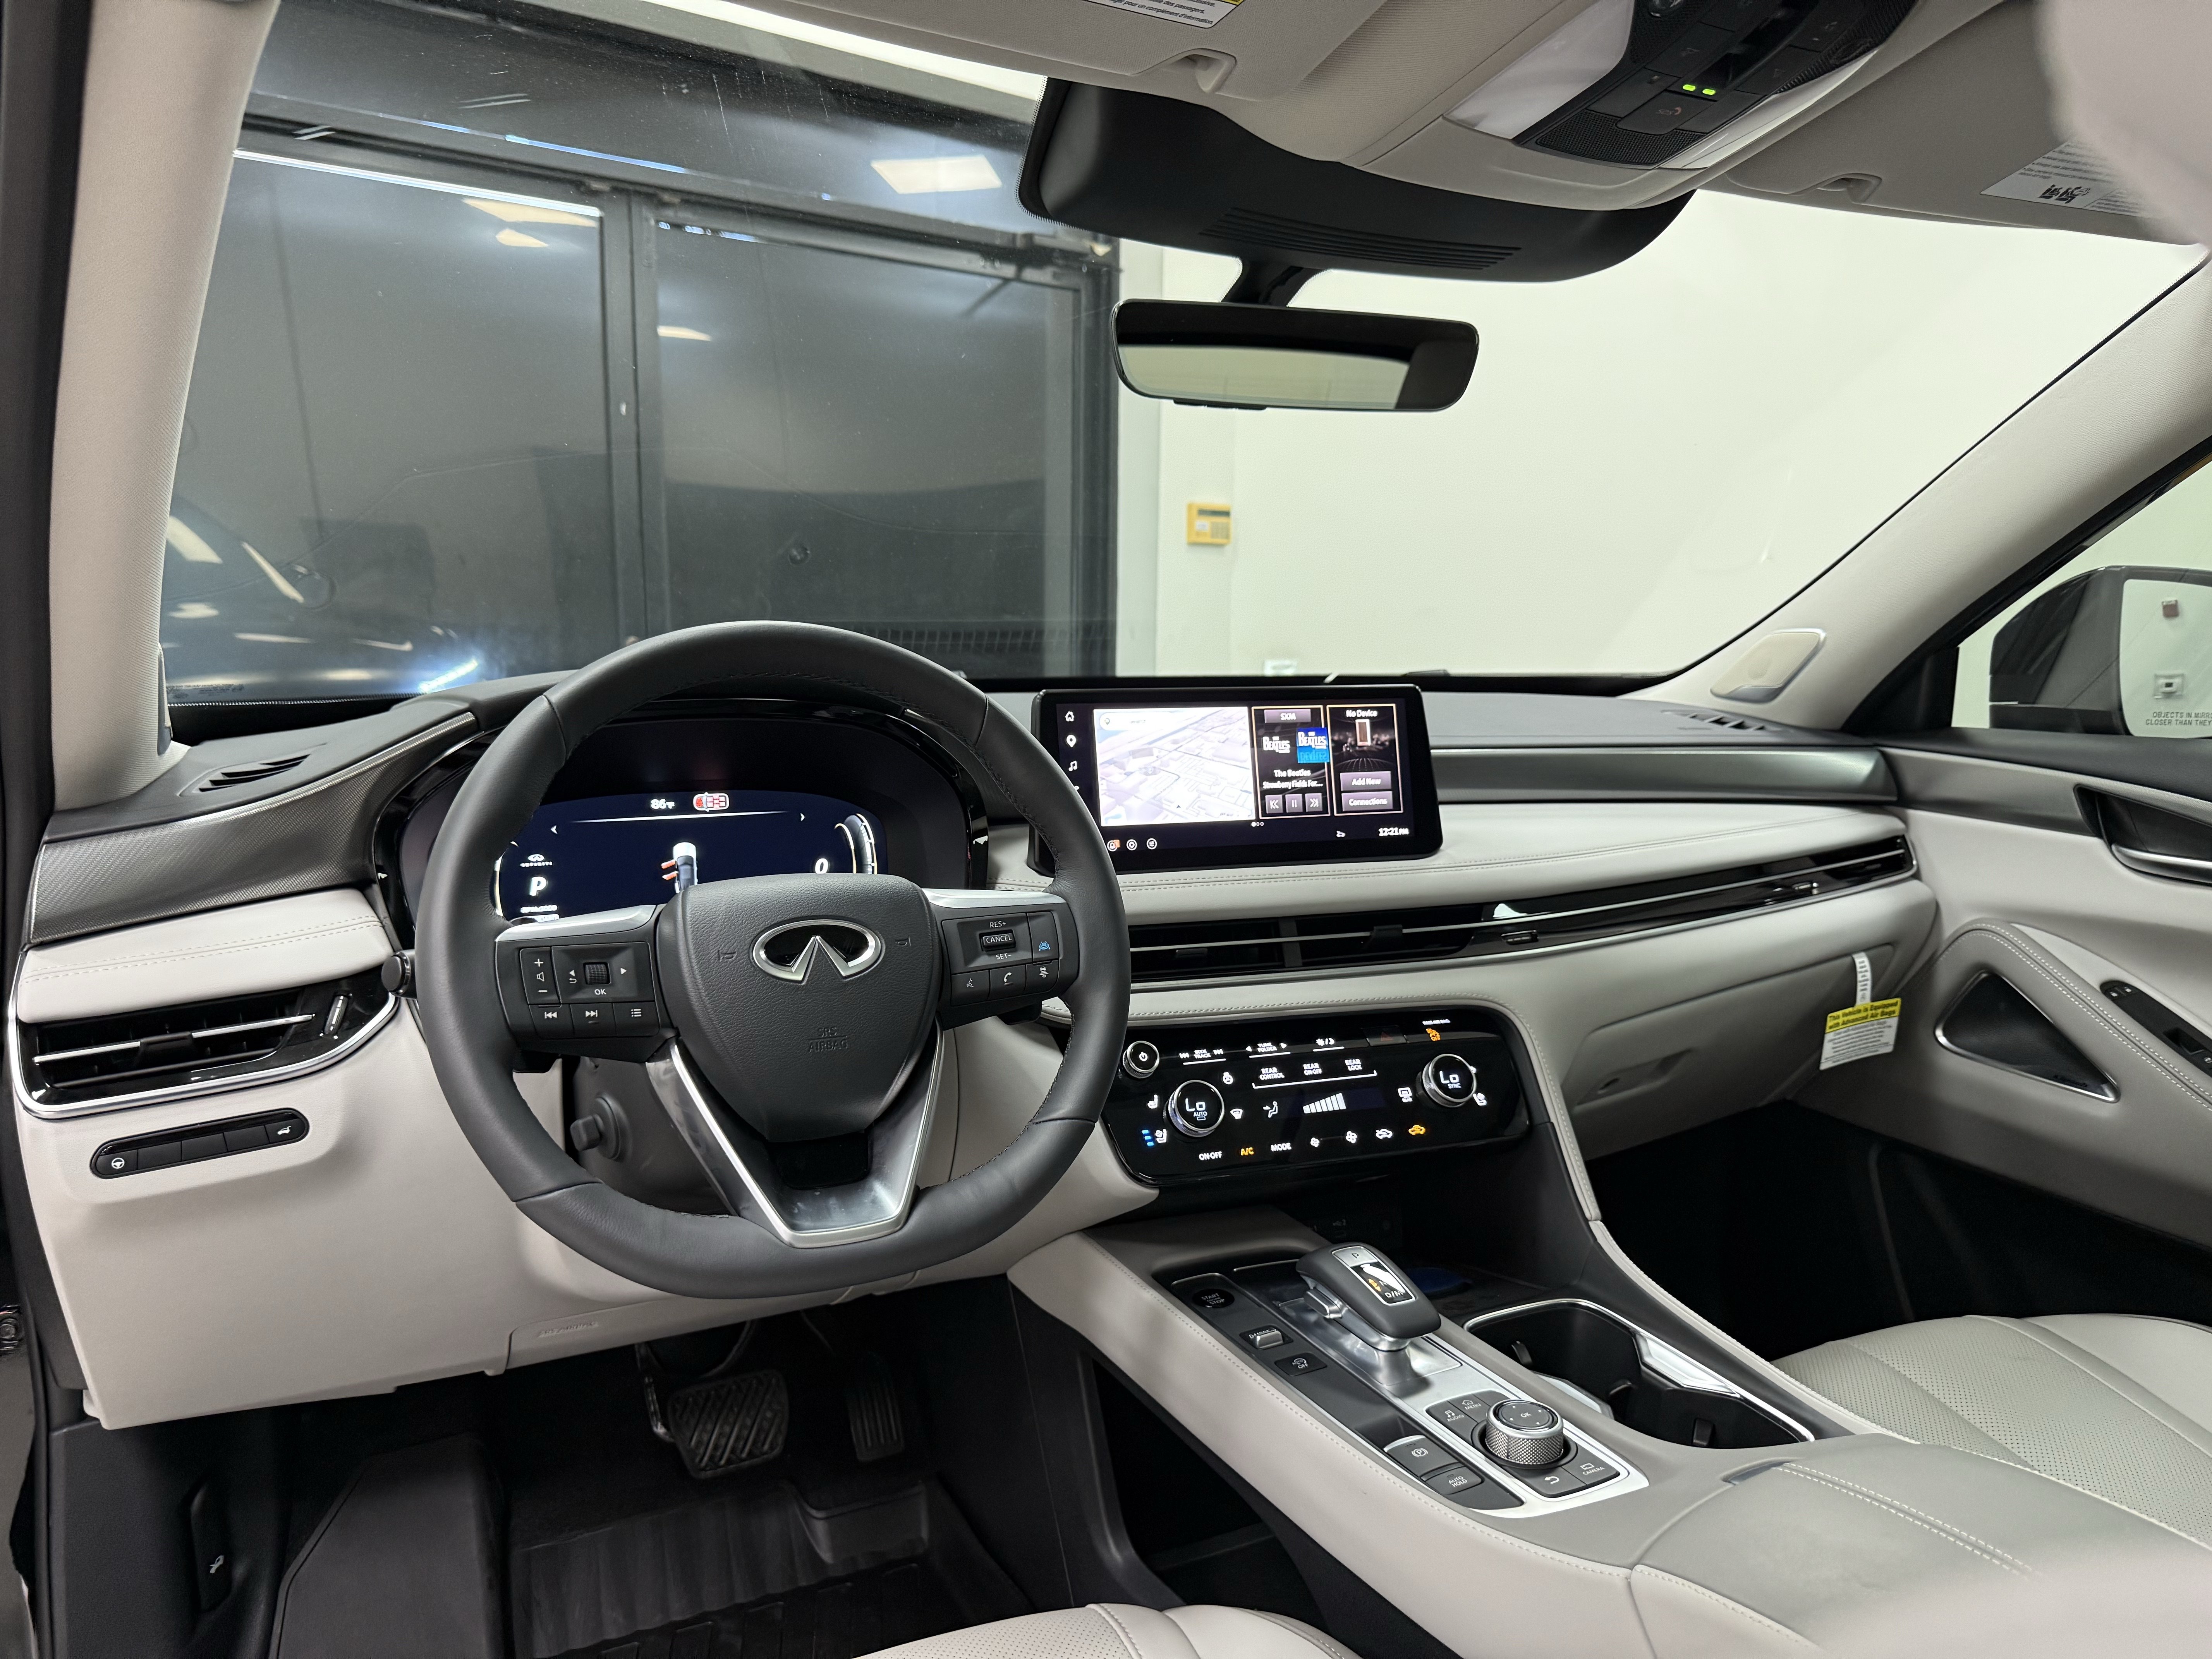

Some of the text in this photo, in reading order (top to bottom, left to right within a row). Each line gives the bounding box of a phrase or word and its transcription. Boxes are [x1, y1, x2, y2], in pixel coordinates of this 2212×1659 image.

[1287, 769, 1311, 777] Beatles
[1349, 798, 1387, 806] Connections
[1379, 827, 1399, 836] 12:21
[815, 858, 828, 874] 0
[529, 876, 547, 896] P
[986, 935, 1012, 943] CANCEL
[809, 1040, 848, 1053] AIRBAG
[1271, 1142, 1291, 1152] MODE
[1240, 1147, 1254, 1156] A/C
[1583, 1467, 1605, 1475] CAMERA
[1448, 1476, 1463, 1484] AUTO
[1451, 1479, 1467, 1487] HOLD
